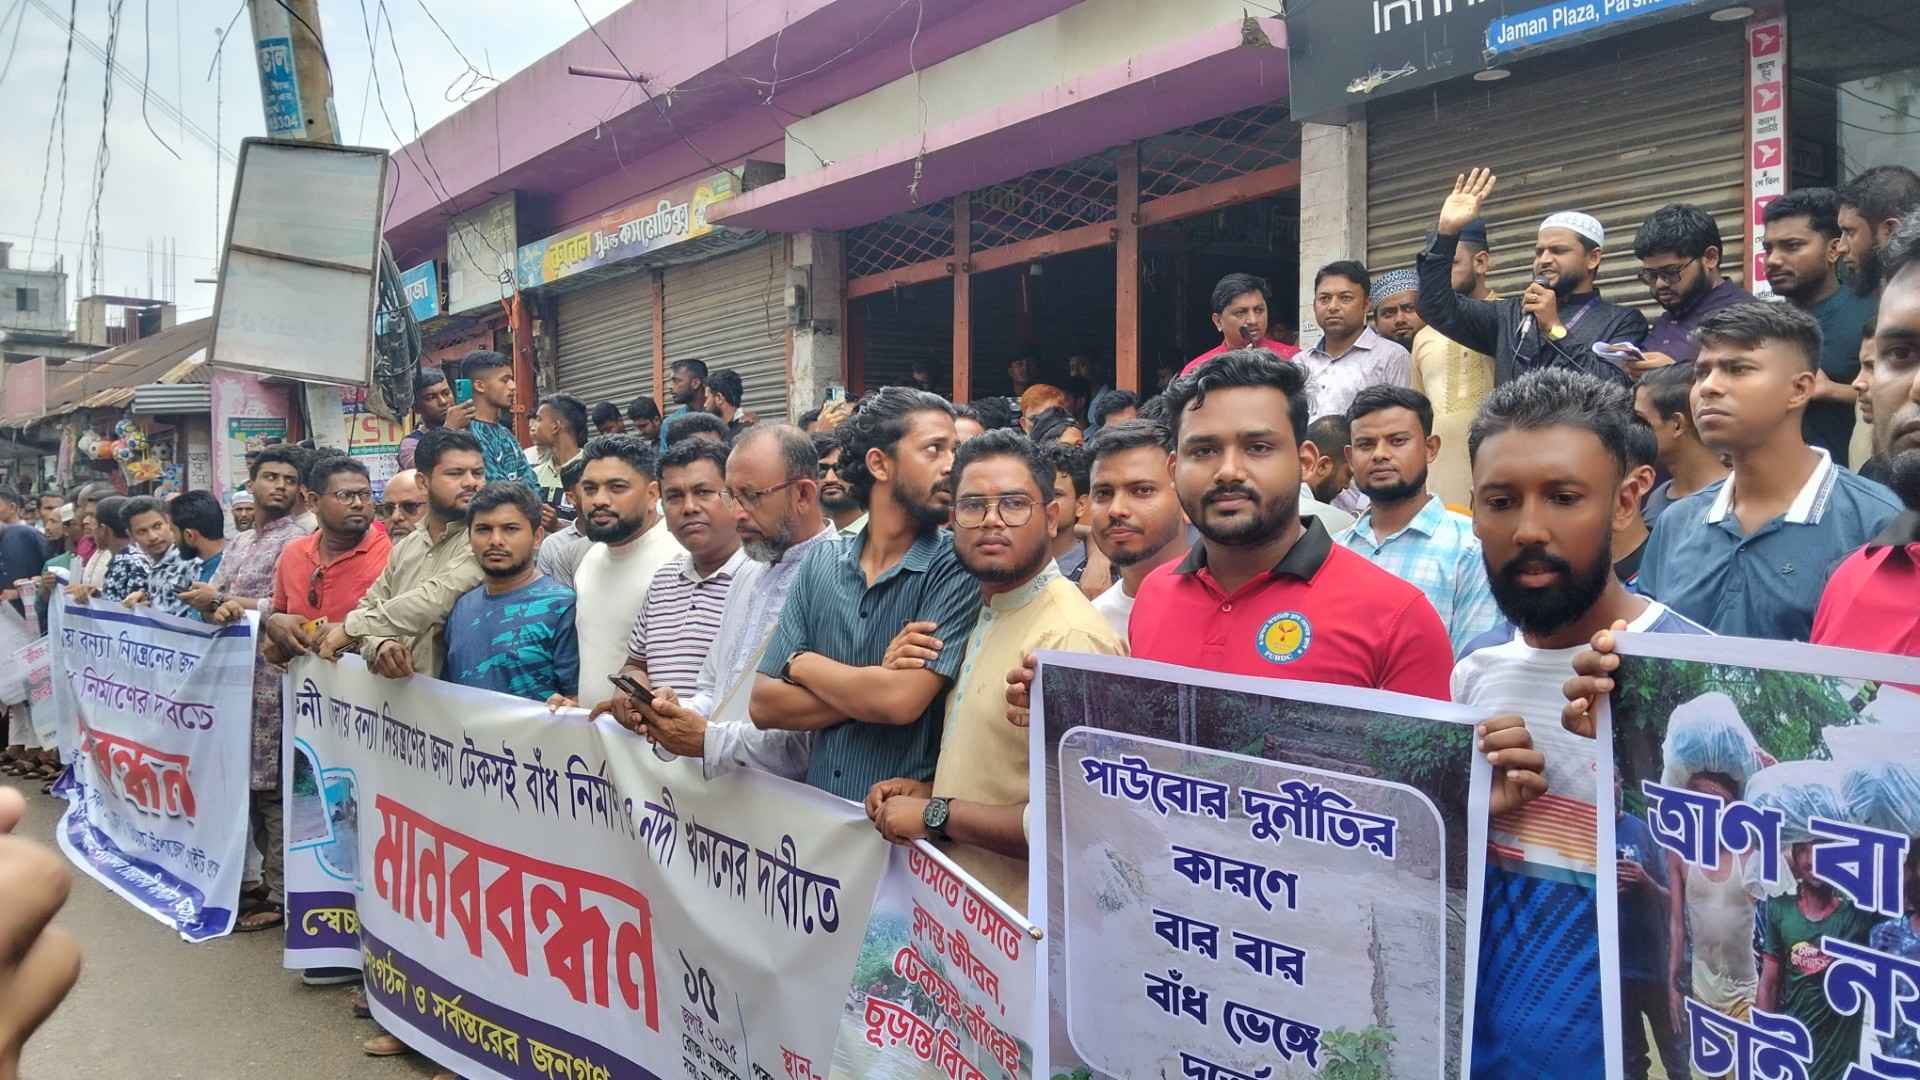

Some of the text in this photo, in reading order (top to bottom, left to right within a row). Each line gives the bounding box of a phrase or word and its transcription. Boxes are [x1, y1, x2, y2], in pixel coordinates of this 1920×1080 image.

[1496, 22, 1548, 44] Jaman
[1552, 6, 1600, 29] Plaza,
[79, 631, 113, 658] বন্যা
[80, 666, 150, 714] নির্মাণের
[354, 705, 379, 752] বন্যা
[429, 734, 454, 787] জন্য
[459, 730, 518, 812] টেকসই
[523, 745, 560, 822] বাঁধ
[638, 786, 680, 868] নদী
[685, 813, 751, 905] খননের
[755, 834, 841, 935] দাবীতে
[1080, 756, 1396, 858] পাউবোর দুর্নীতির
[1641, 780, 1785, 885] ত্রাণ
[373, 793, 660, 1034] মানববন্ধন
[909, 847, 1022, 961] ভাসতে ভাসতে
[1171, 845, 1298, 911] কারণে
[911, 896, 944, 954] ক্লান্ত
[1152, 908, 1305, 985] বার বার
[678, 948, 719, 1024] ১৫
[892, 941, 963, 1028] টেকসই
[1143, 968, 1208, 1025] বাঁধ
[1223, 1000, 1321, 1067] ভেঙ্গে
[412, 985, 426, 1014] ও
[431, 994, 518, 1066] সর্বস্তরের
[864, 997, 937, 1060] চূড়ান্ত
